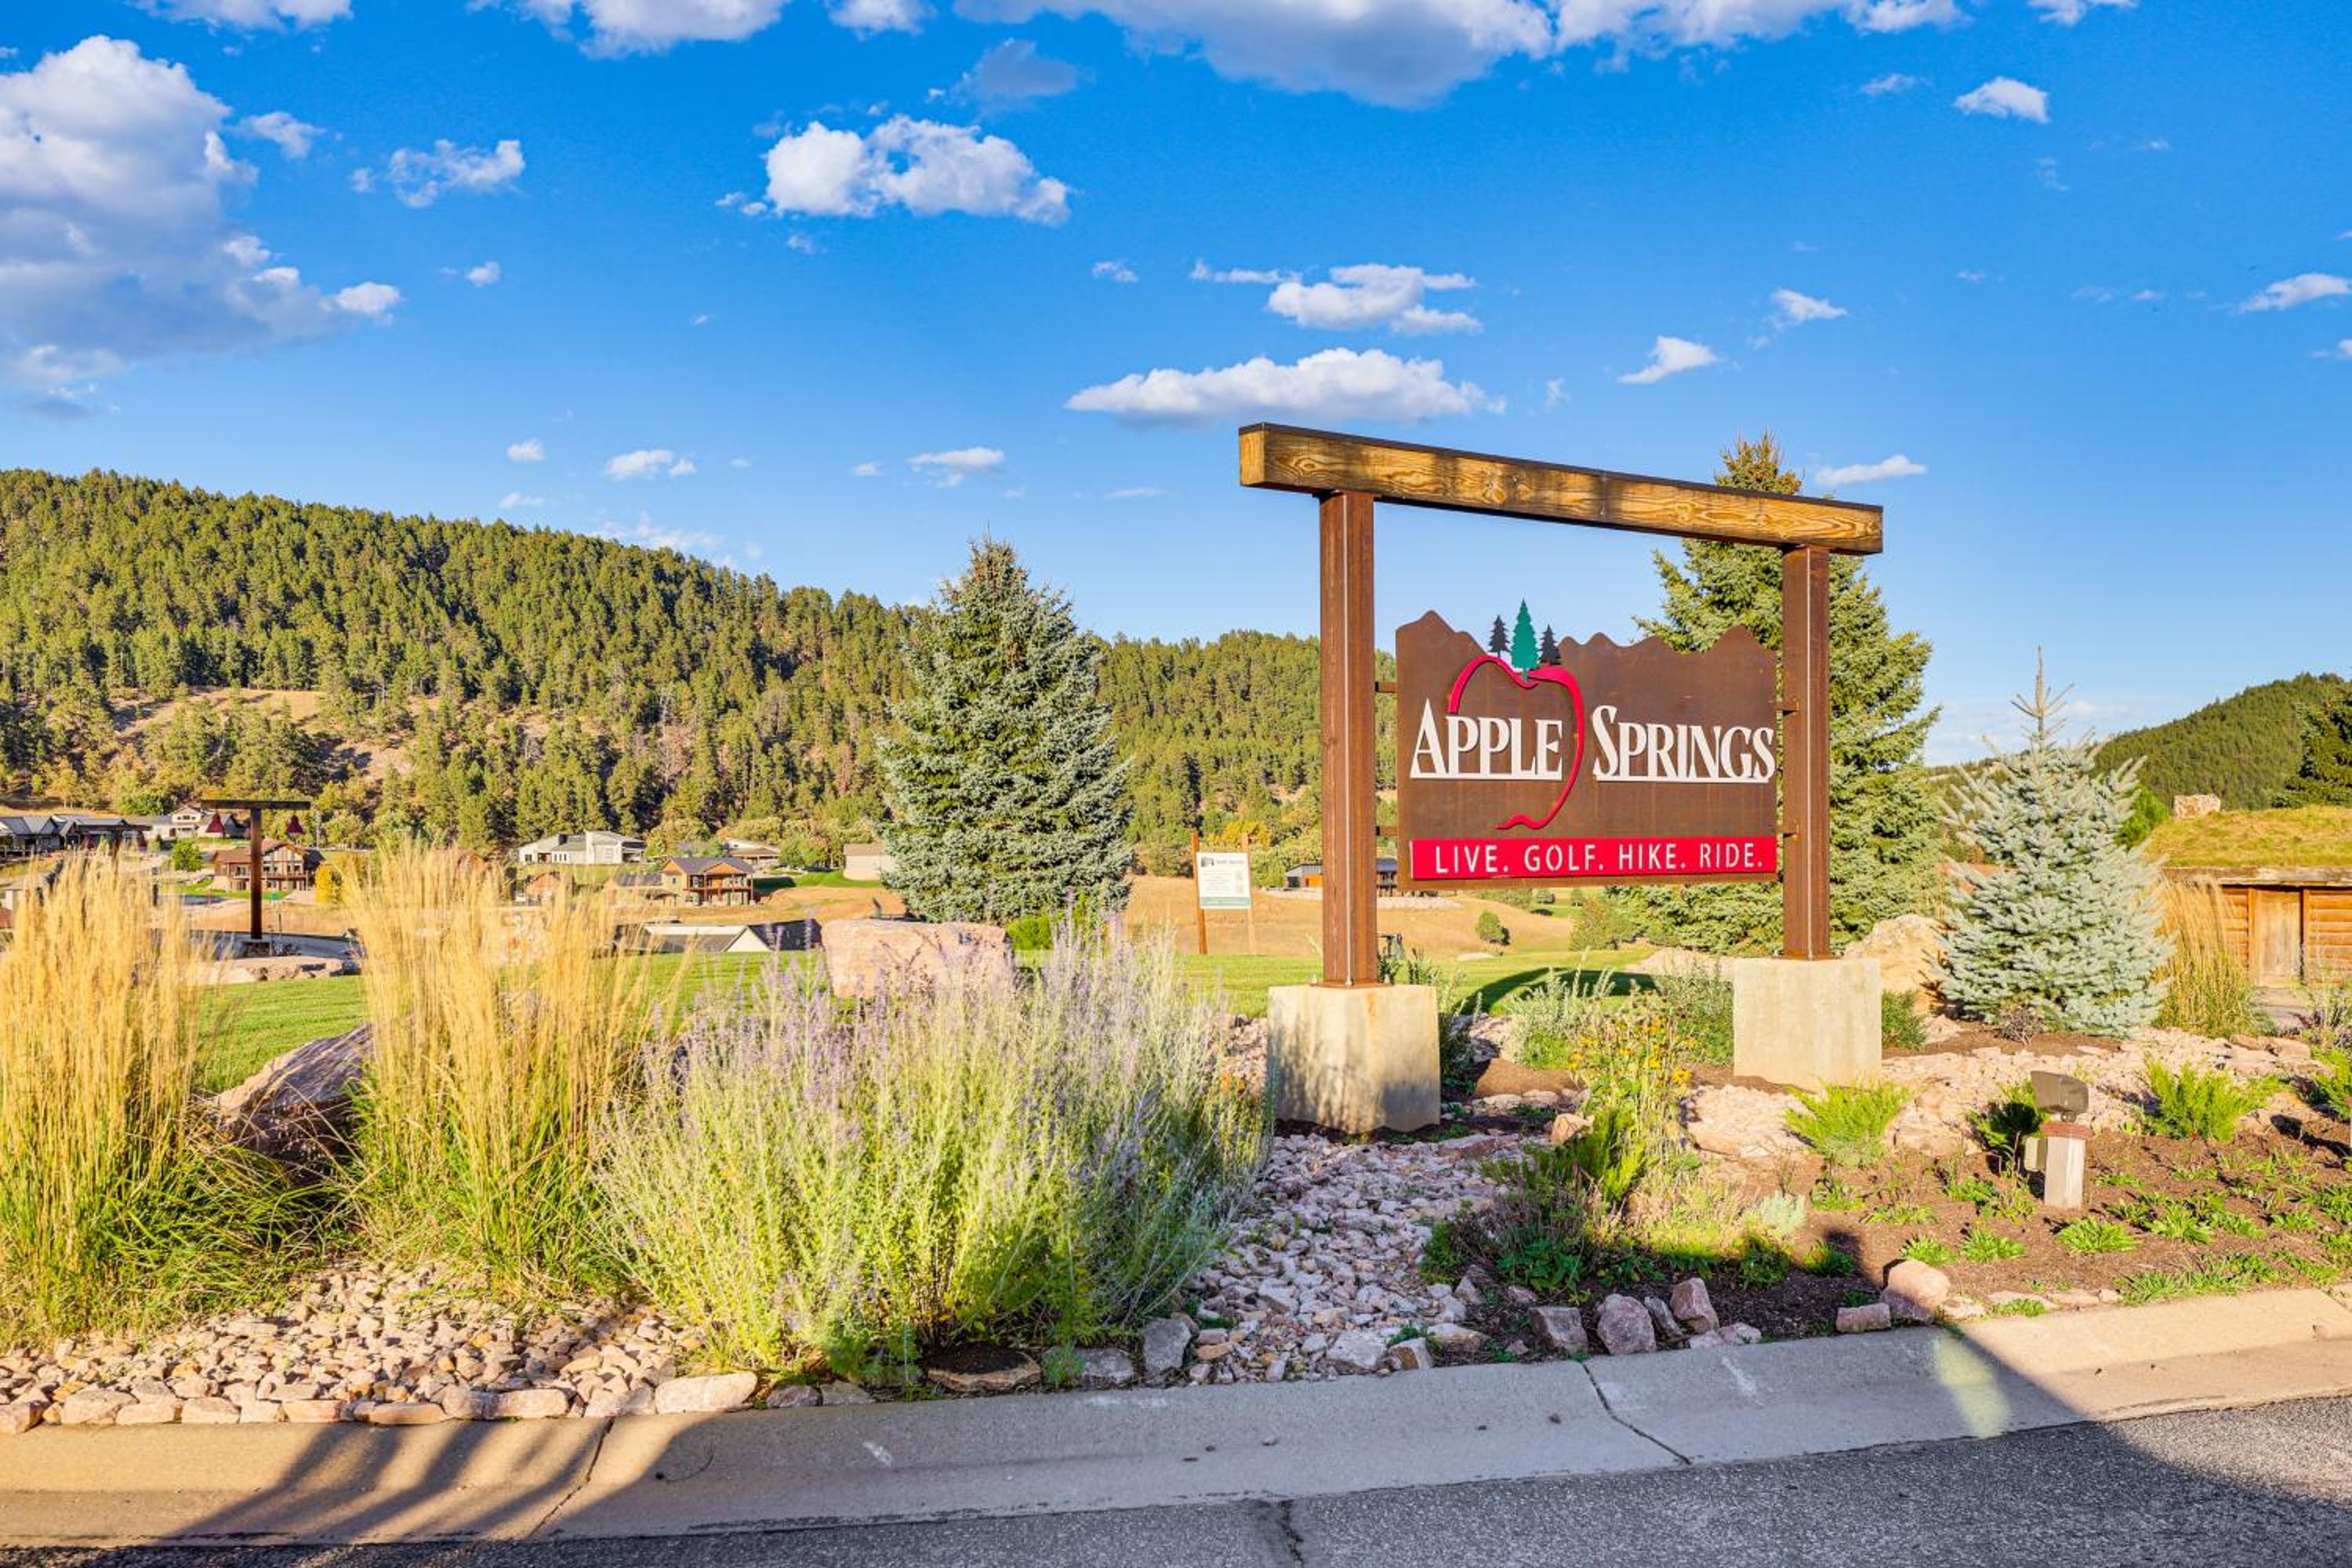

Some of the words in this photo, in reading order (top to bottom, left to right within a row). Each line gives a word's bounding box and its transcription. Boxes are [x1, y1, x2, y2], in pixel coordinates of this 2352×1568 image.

[1410, 698, 1563, 779] APPLE
[1592, 705, 1776, 782] SPRINGS
[1435, 845, 1509, 873] LIVE.
[1524, 844, 1604, 872] GOLF.
[1618, 844, 1686, 870] HIKE.
[1699, 843, 1762, 868] RIDE.
